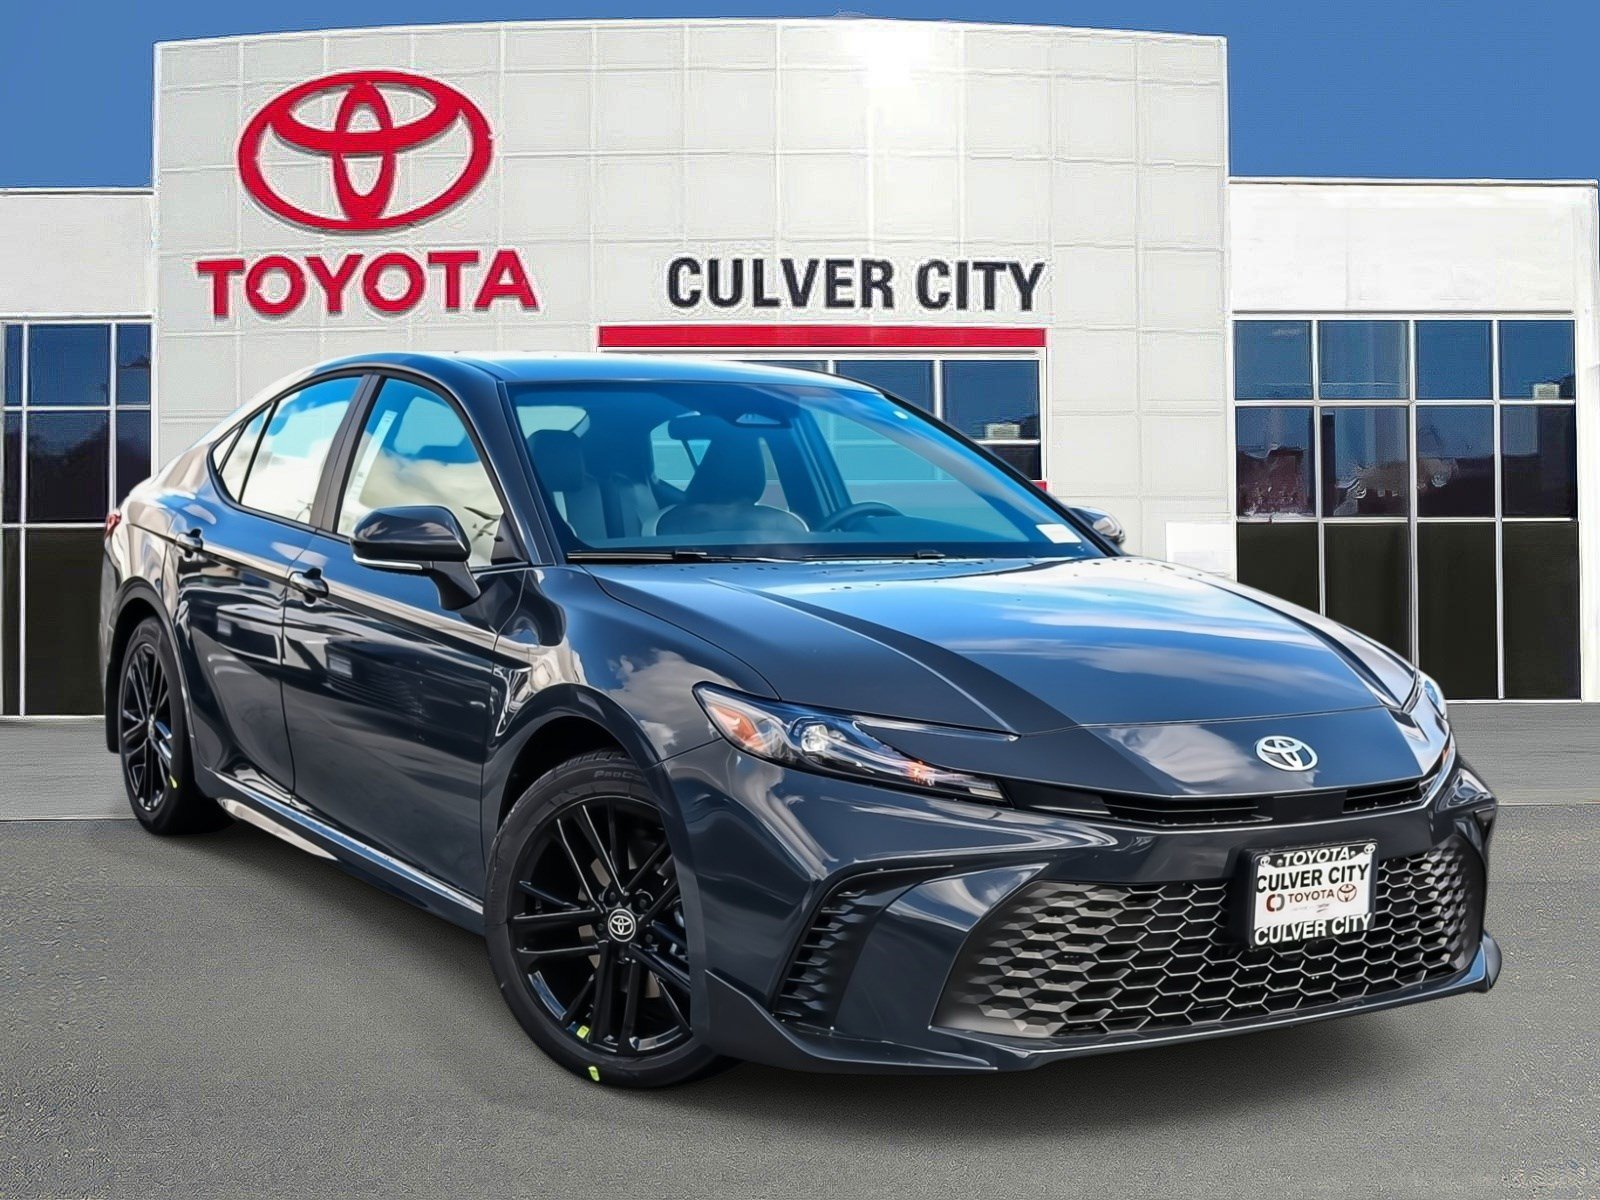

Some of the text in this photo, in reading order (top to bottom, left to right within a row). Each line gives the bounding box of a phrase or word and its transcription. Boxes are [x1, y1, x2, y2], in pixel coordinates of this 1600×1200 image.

[195, 249, 539, 318] TOYOTA
[667, 257, 1046, 312] CULVER CITY
[1283, 846, 1350, 866] TOYOTA
[1256, 863, 1370, 893] CULVER CITY
[1288, 889, 1335, 903] TOYOTA
[1254, 912, 1372, 946] CULVER CITY
